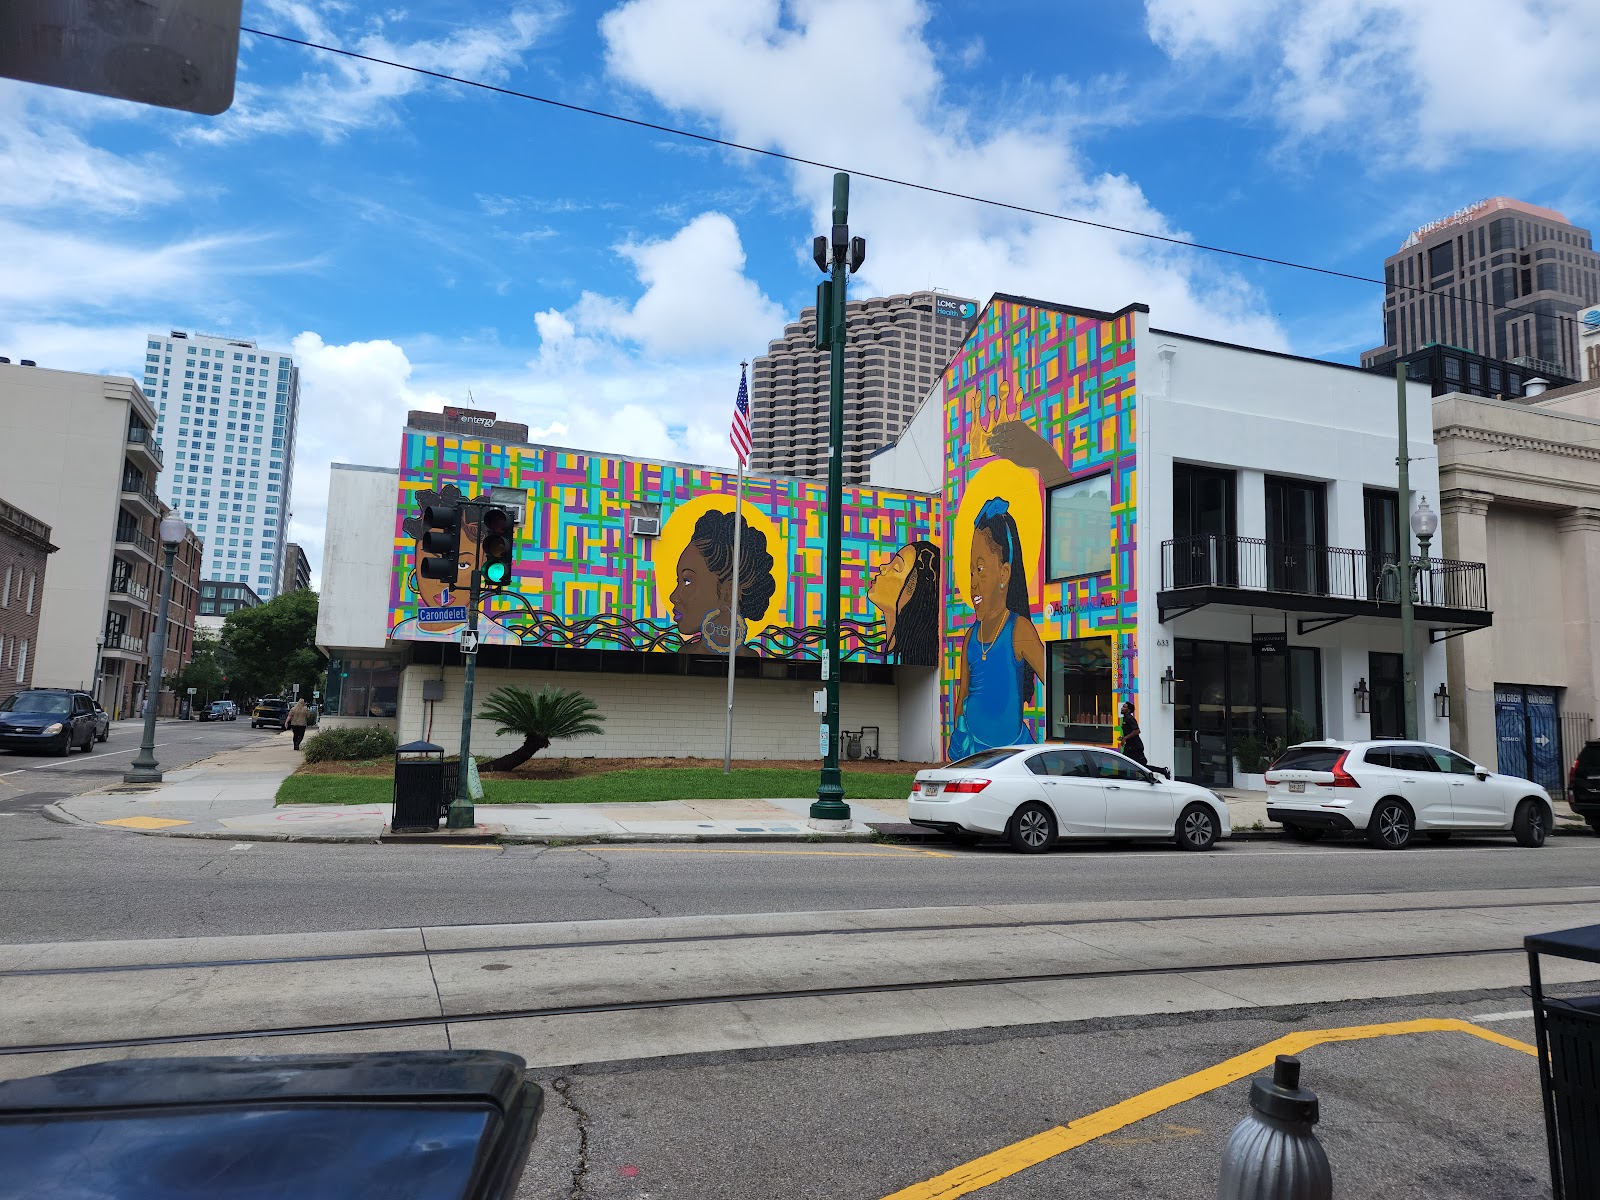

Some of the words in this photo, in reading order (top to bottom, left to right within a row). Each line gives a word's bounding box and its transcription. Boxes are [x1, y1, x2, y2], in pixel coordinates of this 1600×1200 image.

[1418, 215, 1449, 236] FIRST
[1454, 199, 1488, 220] BANK
[937, 299, 956, 309] LCMC
[937, 307, 959, 317] Health
[461, 416, 496, 428] entergy
[420, 609, 465, 621] Carondelet
[1156, 639, 1170, 647] 633
[1495, 693, 1506, 702] VAN
[1506, 694, 1522, 703] GOGH
[1527, 694, 1539, 704] VAN
[1539, 695, 1554, 704] GOGH
